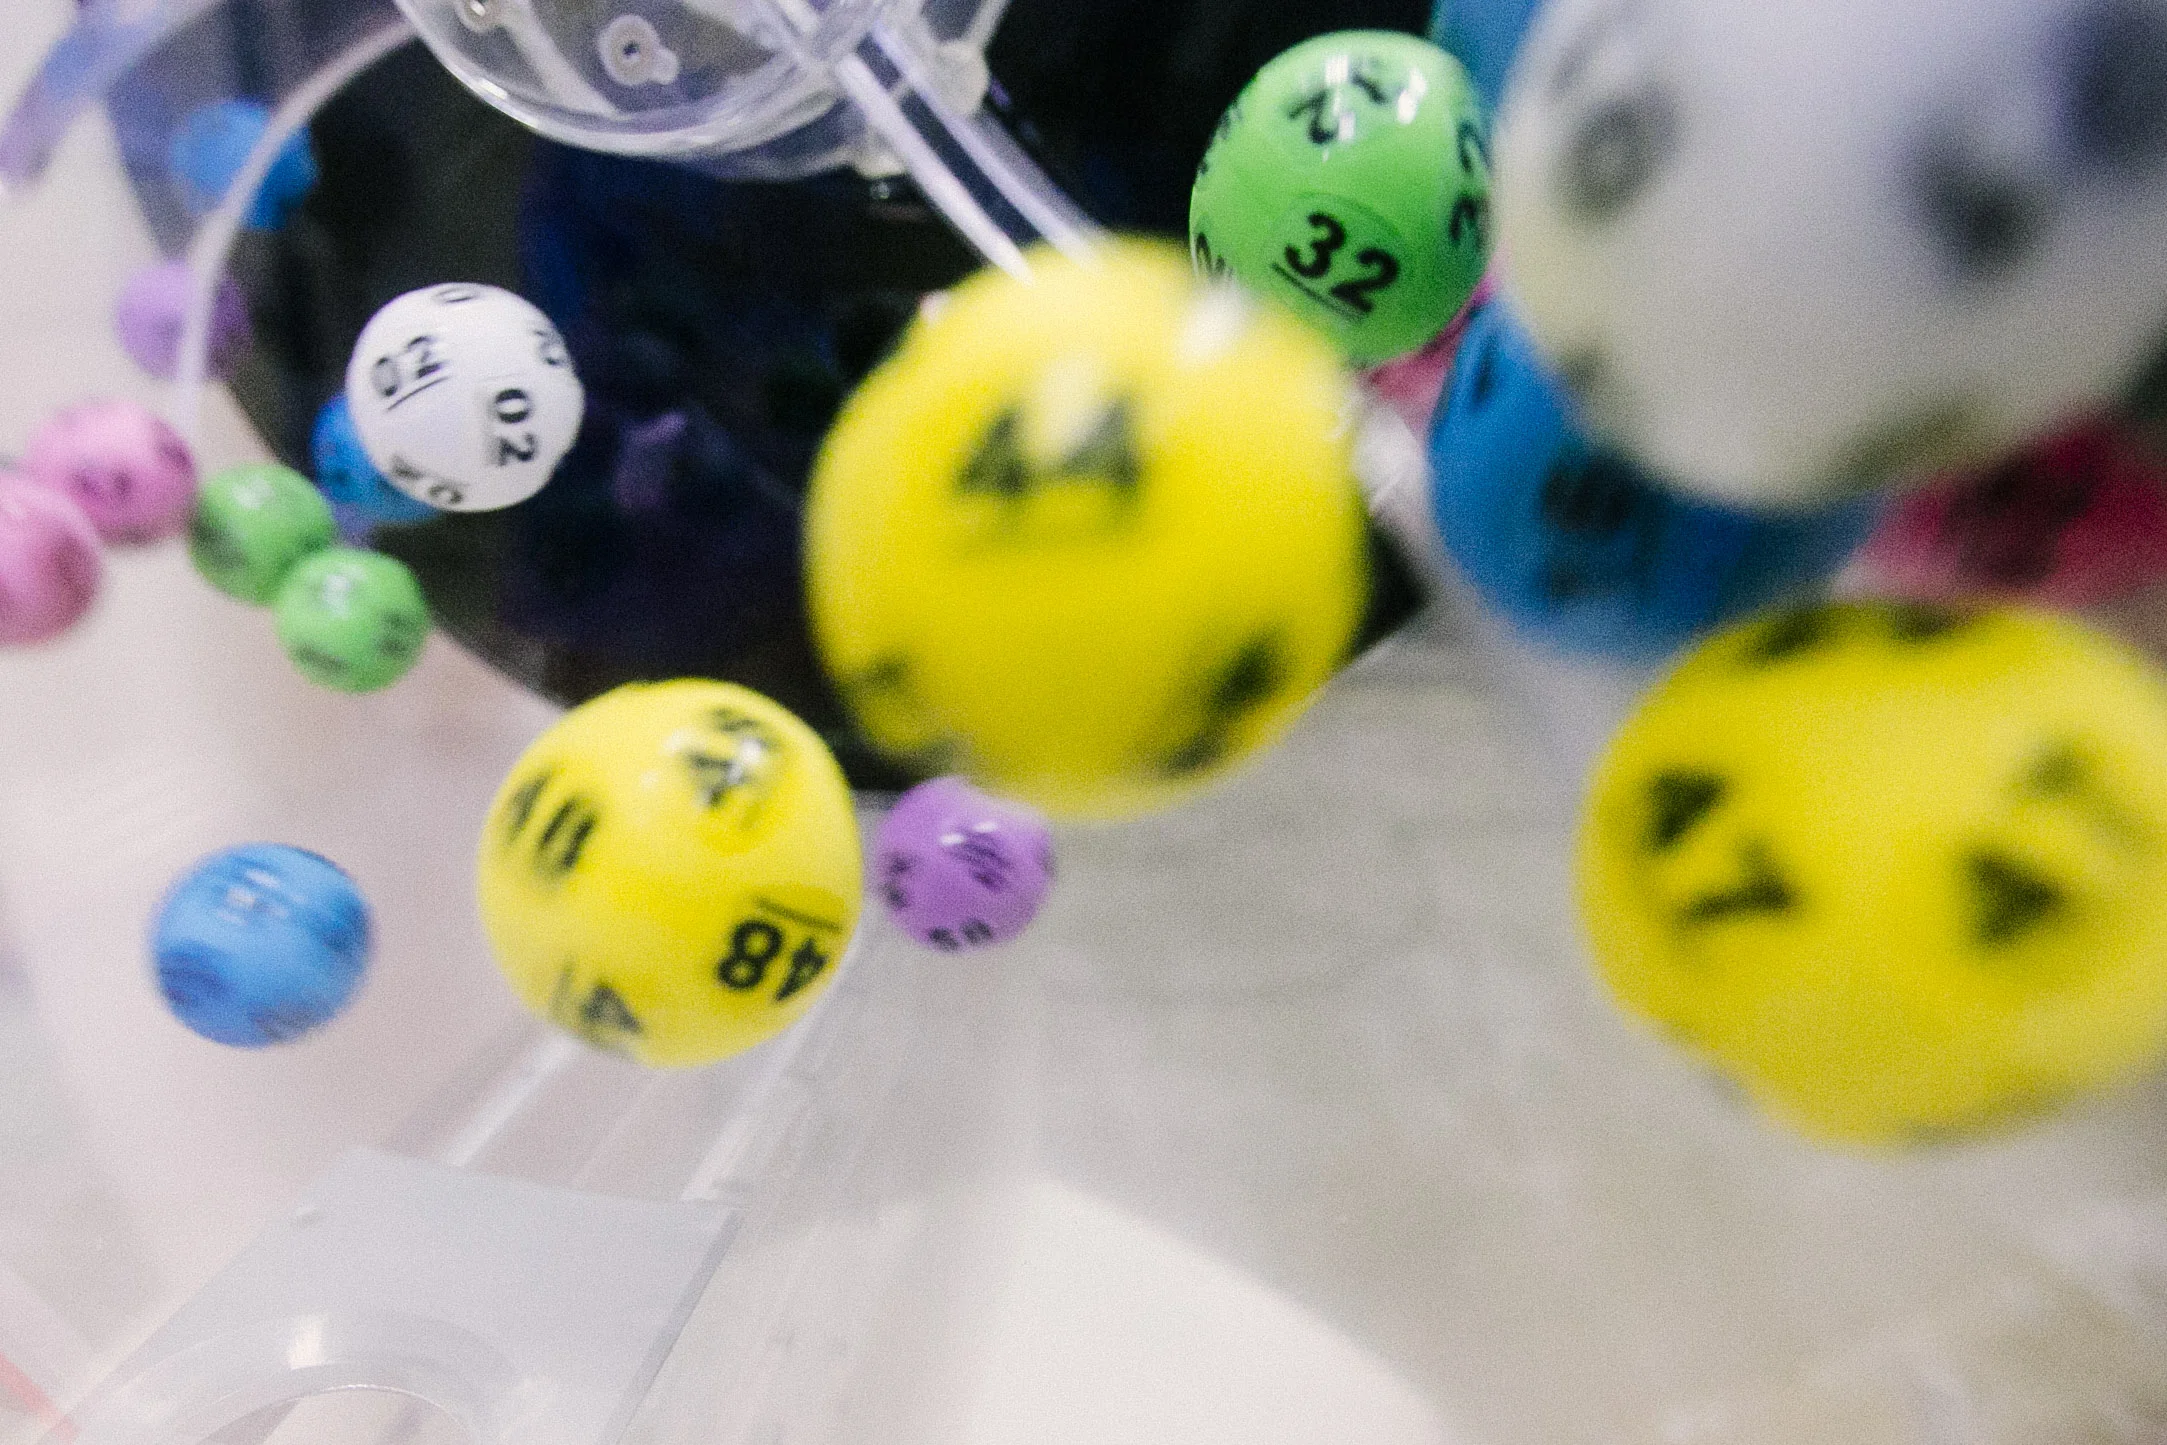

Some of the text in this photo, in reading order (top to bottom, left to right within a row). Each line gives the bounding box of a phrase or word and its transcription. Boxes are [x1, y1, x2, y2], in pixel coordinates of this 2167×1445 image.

[1284, 211, 1398, 313] 32
[492, 387, 538, 467] 02
[950, 392, 1146, 502] 44
[717, 919, 829, 1003] 48
